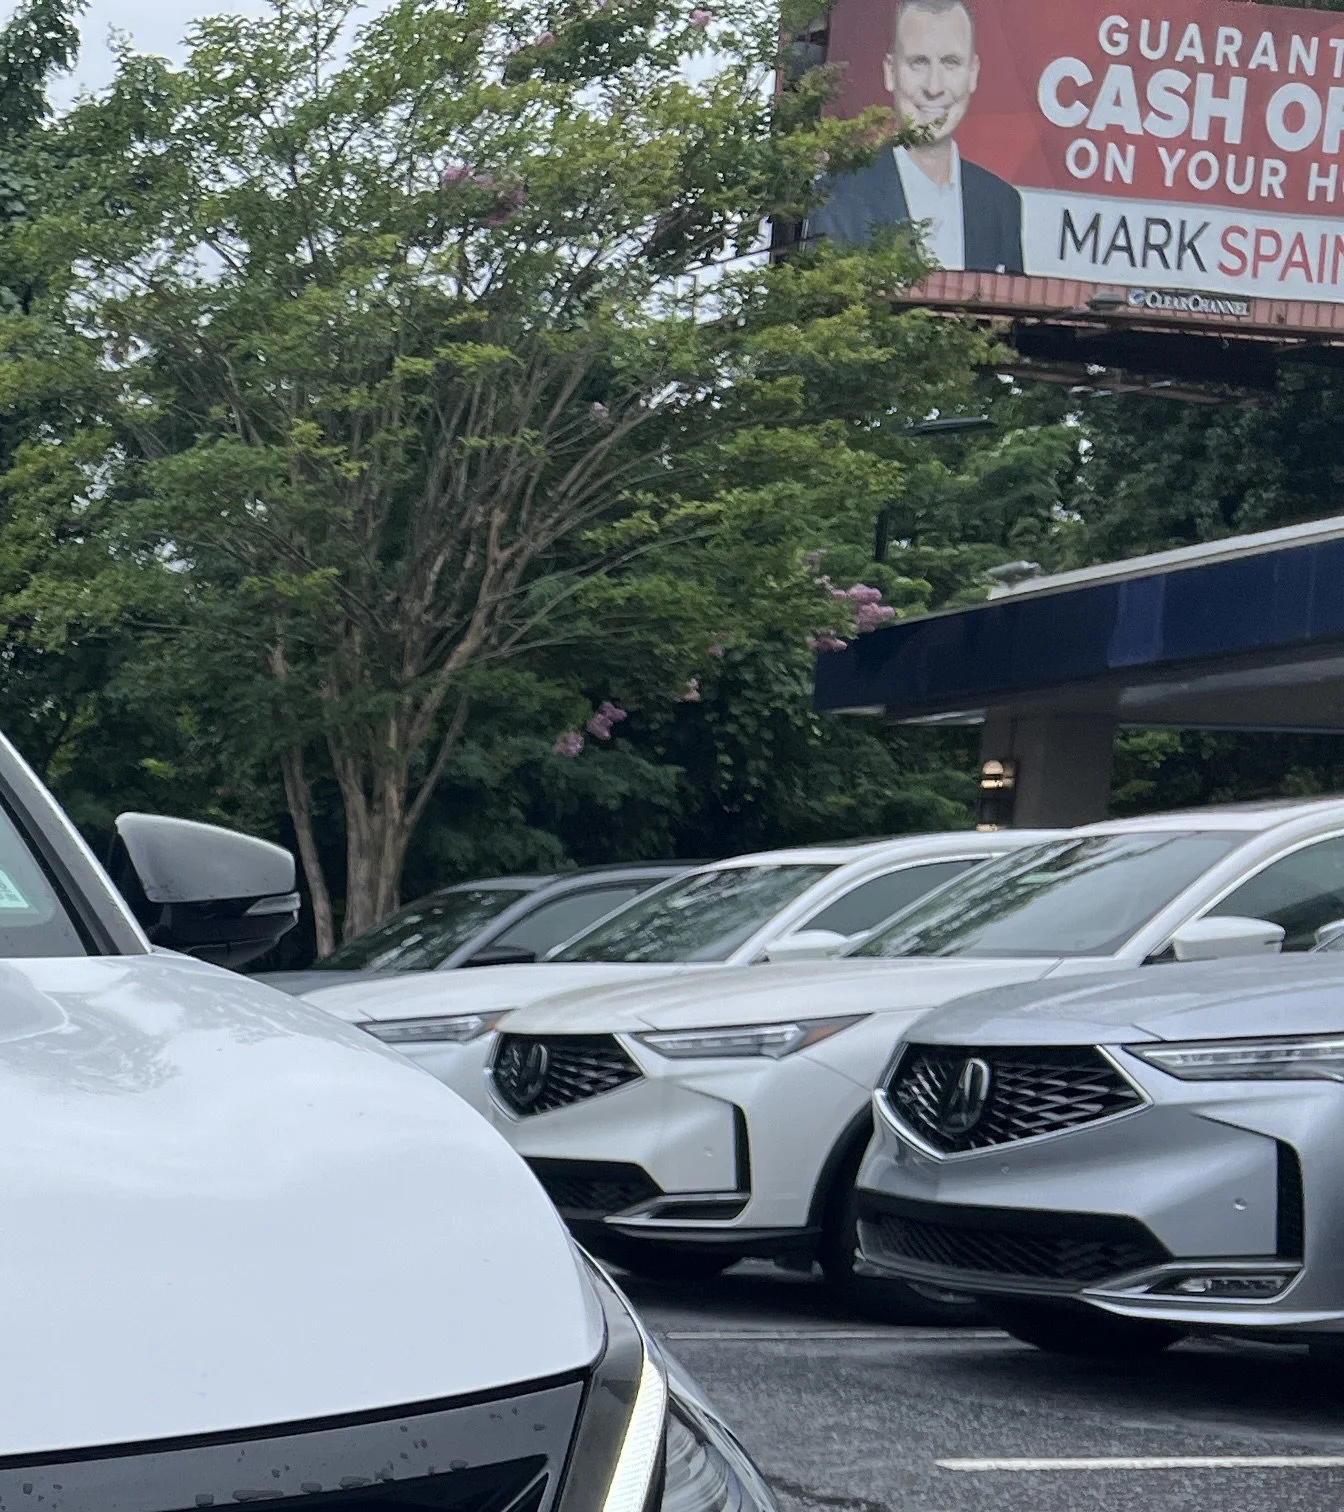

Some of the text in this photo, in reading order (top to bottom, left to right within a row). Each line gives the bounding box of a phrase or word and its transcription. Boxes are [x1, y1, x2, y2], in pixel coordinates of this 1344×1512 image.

[1099, 15, 1344, 78] GUARANT
[1037, 56, 1248, 145] CASH
[1066, 139, 1344, 203] ON YOUR H
[1059, 209, 1211, 273] MARK
